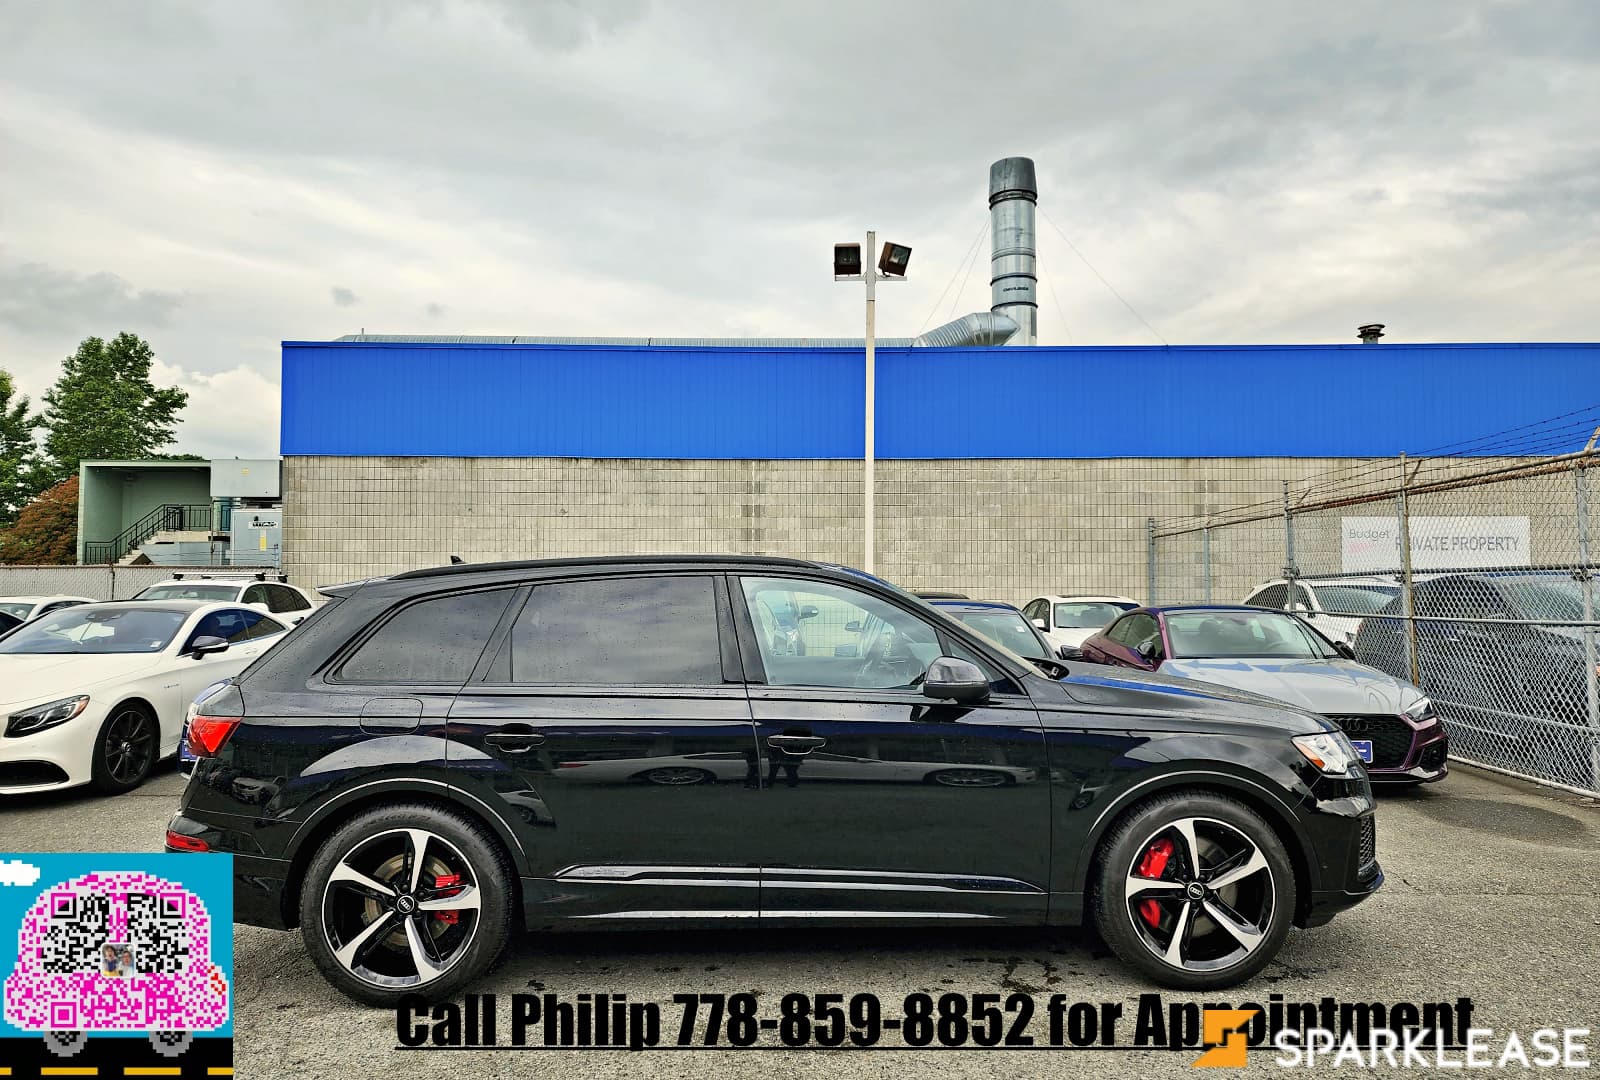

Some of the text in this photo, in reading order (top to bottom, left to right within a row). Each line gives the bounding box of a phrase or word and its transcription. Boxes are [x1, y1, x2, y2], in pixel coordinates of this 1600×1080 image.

[1349, 528, 1389, 541] Budget
[1395, 536, 1519, 551] PIVATE PROPERTY
